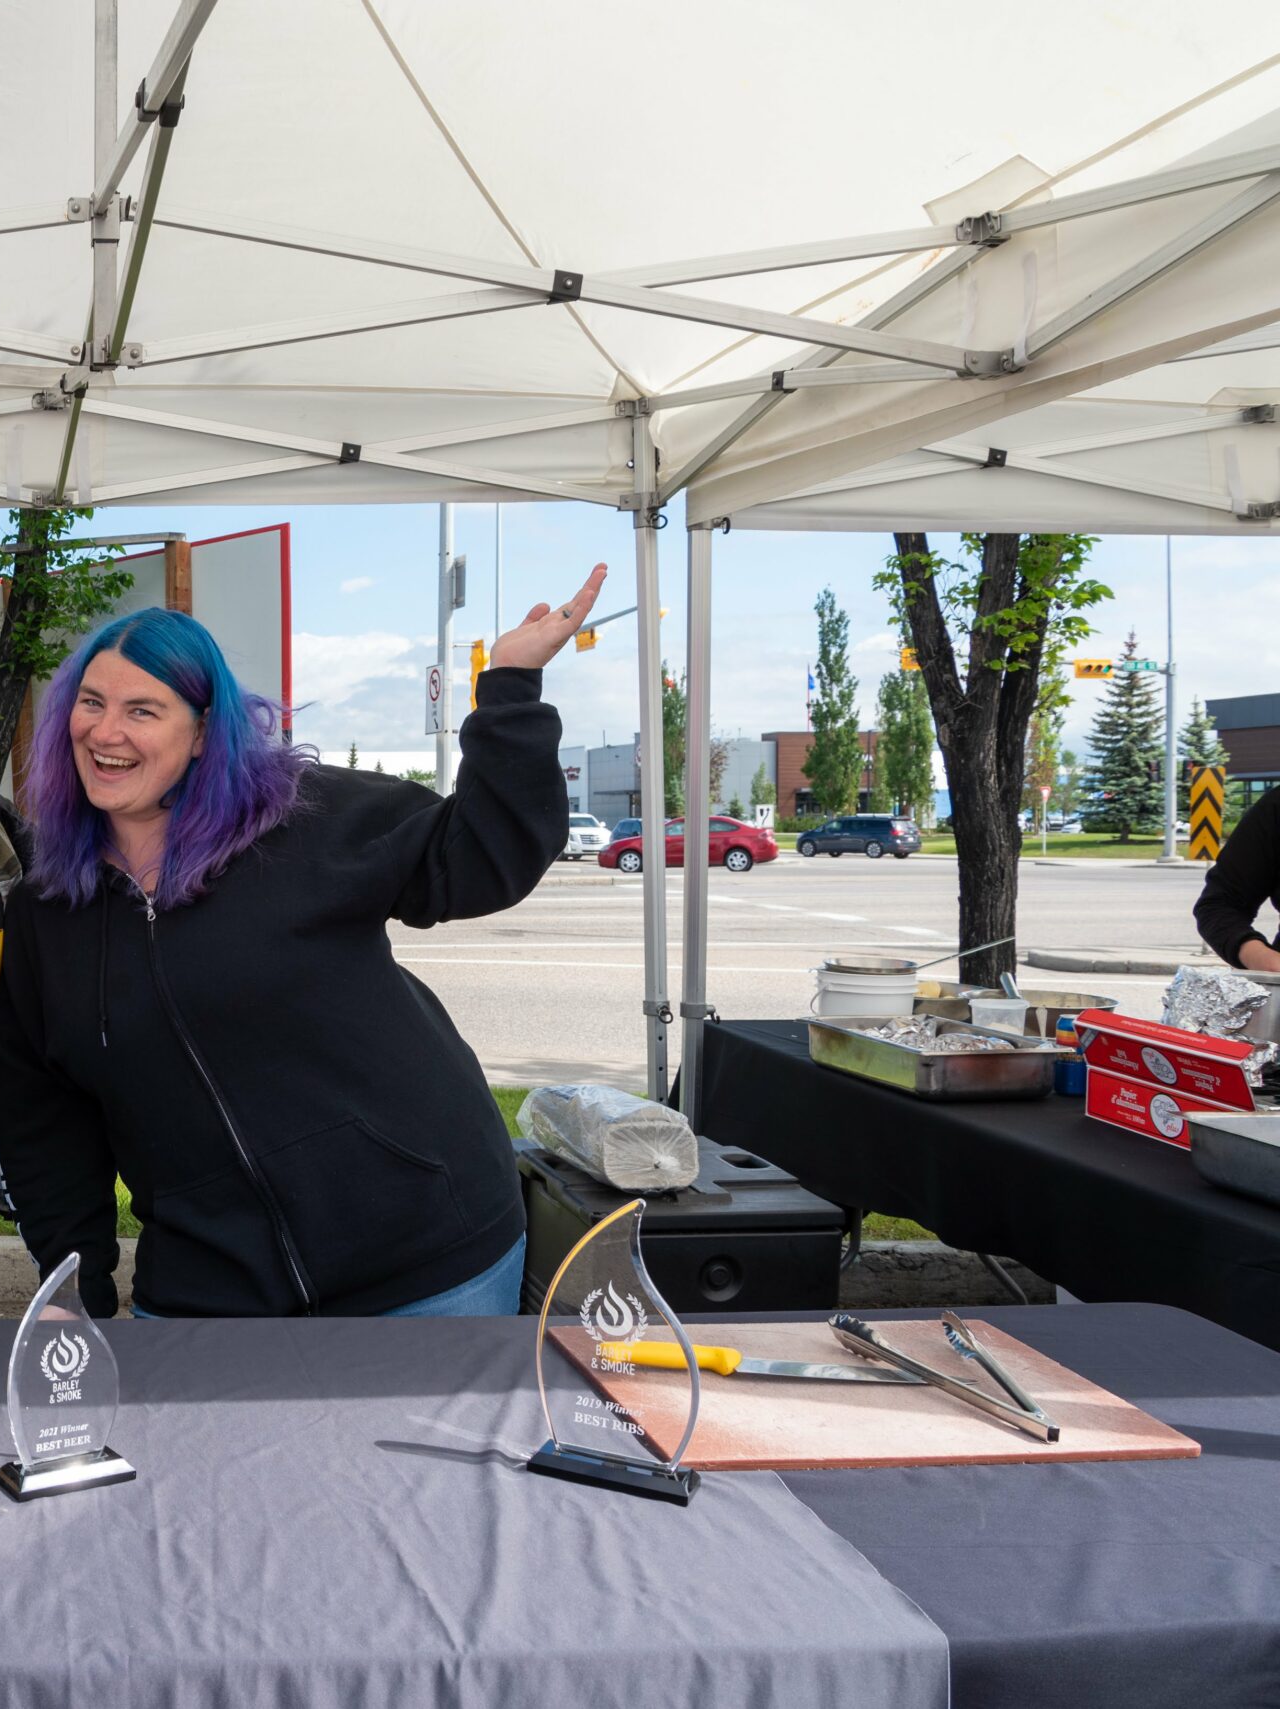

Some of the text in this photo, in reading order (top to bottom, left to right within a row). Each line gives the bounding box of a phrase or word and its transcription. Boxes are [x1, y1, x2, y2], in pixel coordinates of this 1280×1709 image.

[595, 1344, 632, 1361] BARLEY
[591, 1358, 636, 1376] & SMOKE
[52, 1379, 80, 1393] BARLEY
[49, 1389, 82, 1404] & SMOKE
[575, 1395, 645, 1418] 2019 Winner
[60, 1423, 89, 1434] Winner
[574, 1411, 646, 1436] BEST RIBS
[36, 1434, 91, 1453] BEST BEER
